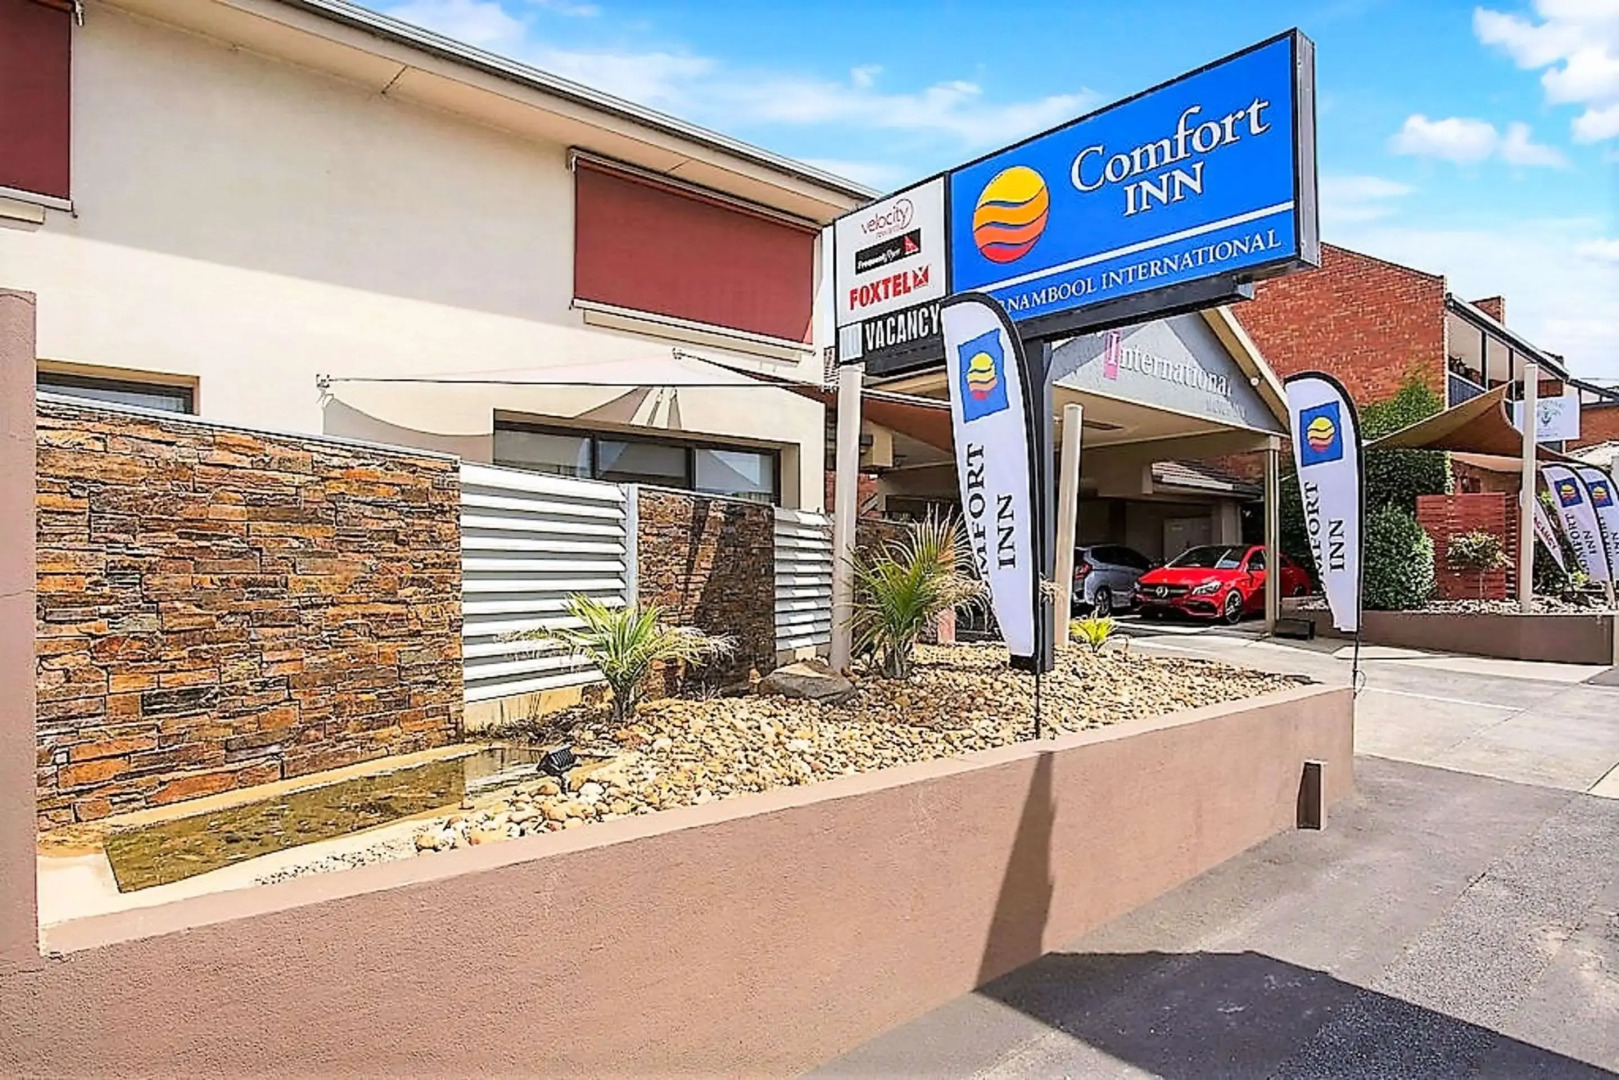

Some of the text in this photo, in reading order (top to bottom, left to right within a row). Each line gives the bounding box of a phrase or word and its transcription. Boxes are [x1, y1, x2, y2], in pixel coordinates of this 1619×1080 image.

[1070, 98, 1270, 192] Comfort
[1123, 161, 1204, 217] INN
[1101, 229, 1282, 290] INTERNATIONAL
[850, 271, 912, 311] FOXTEL
[865, 304, 940, 351] VACANCY
[997, 494, 1016, 570] INN
[1328, 519, 1345, 572] INN
[1583, 530, 1597, 555] INN
